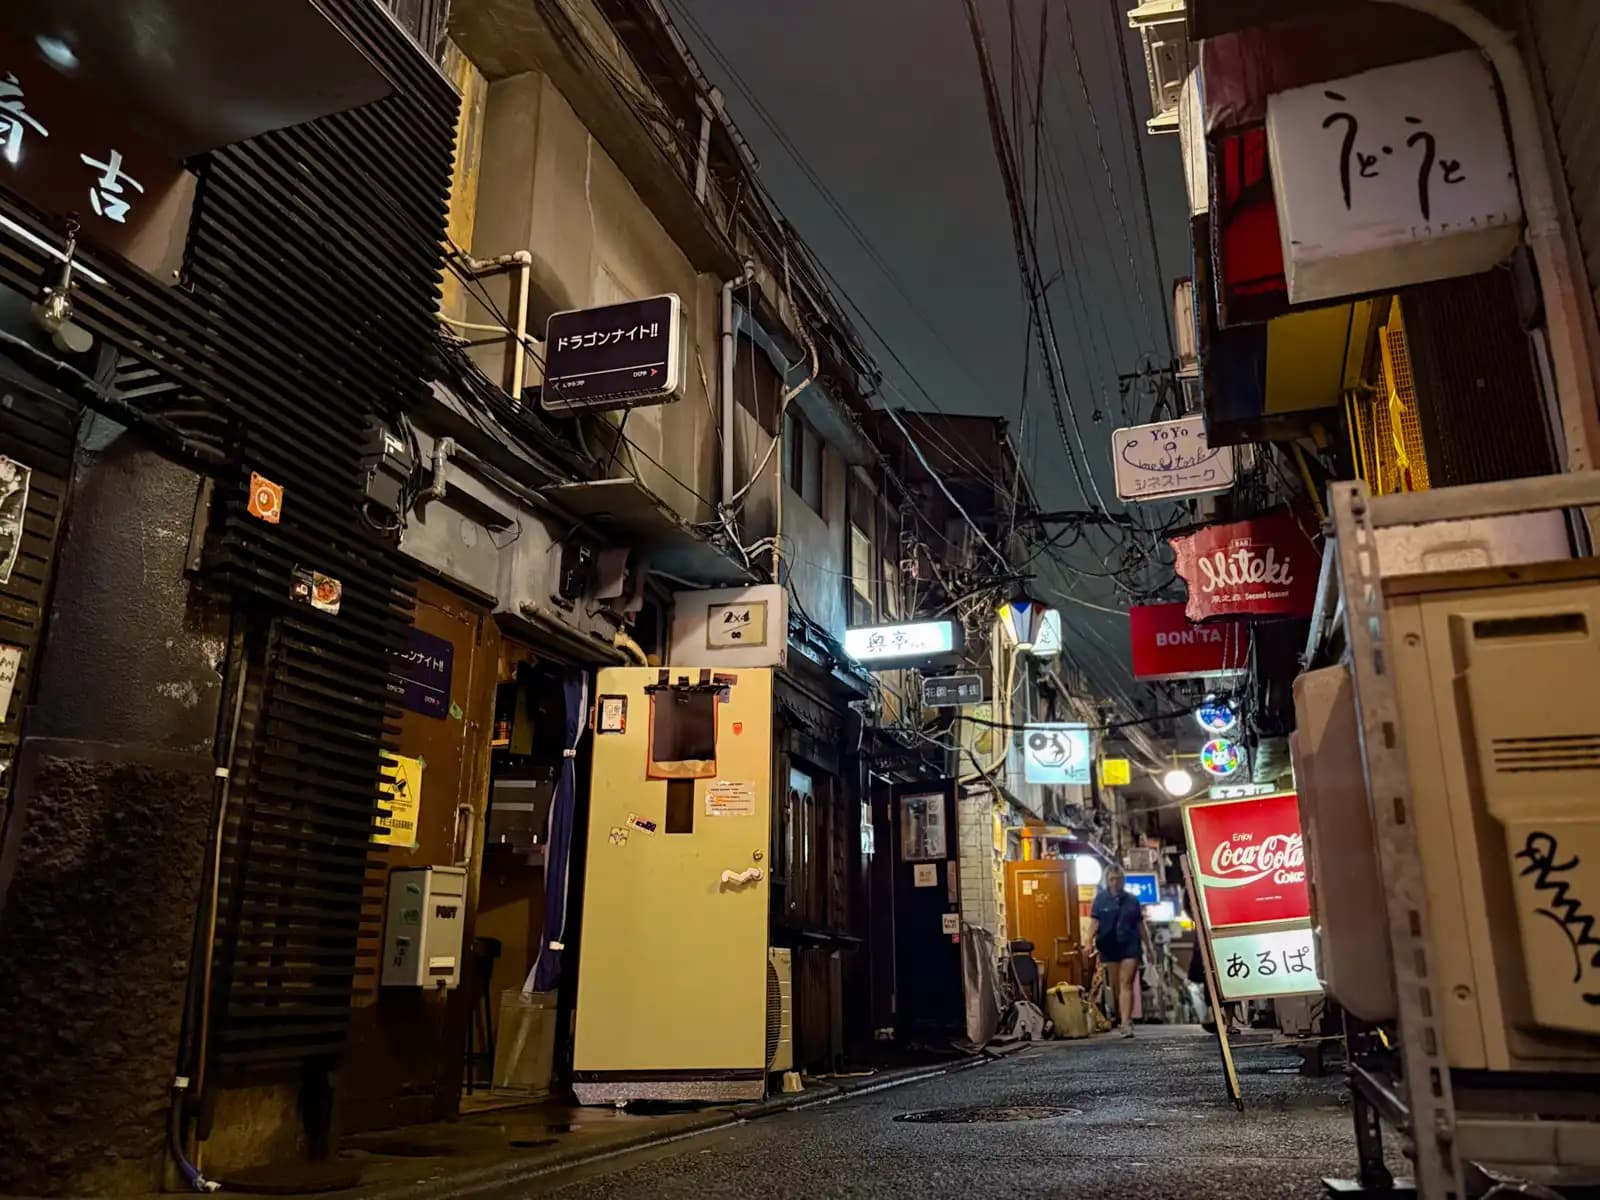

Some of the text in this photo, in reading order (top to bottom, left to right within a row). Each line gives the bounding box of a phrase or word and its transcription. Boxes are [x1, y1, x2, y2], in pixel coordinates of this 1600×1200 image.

[1135, 470, 1215, 491] シネストーク
[1156, 628, 1223, 646] BONTA
[1232, 833, 1253, 842] Enjoy
[1211, 833, 1304, 874] Coca-Cola
[1226, 946, 1312, 979] あるぱ
